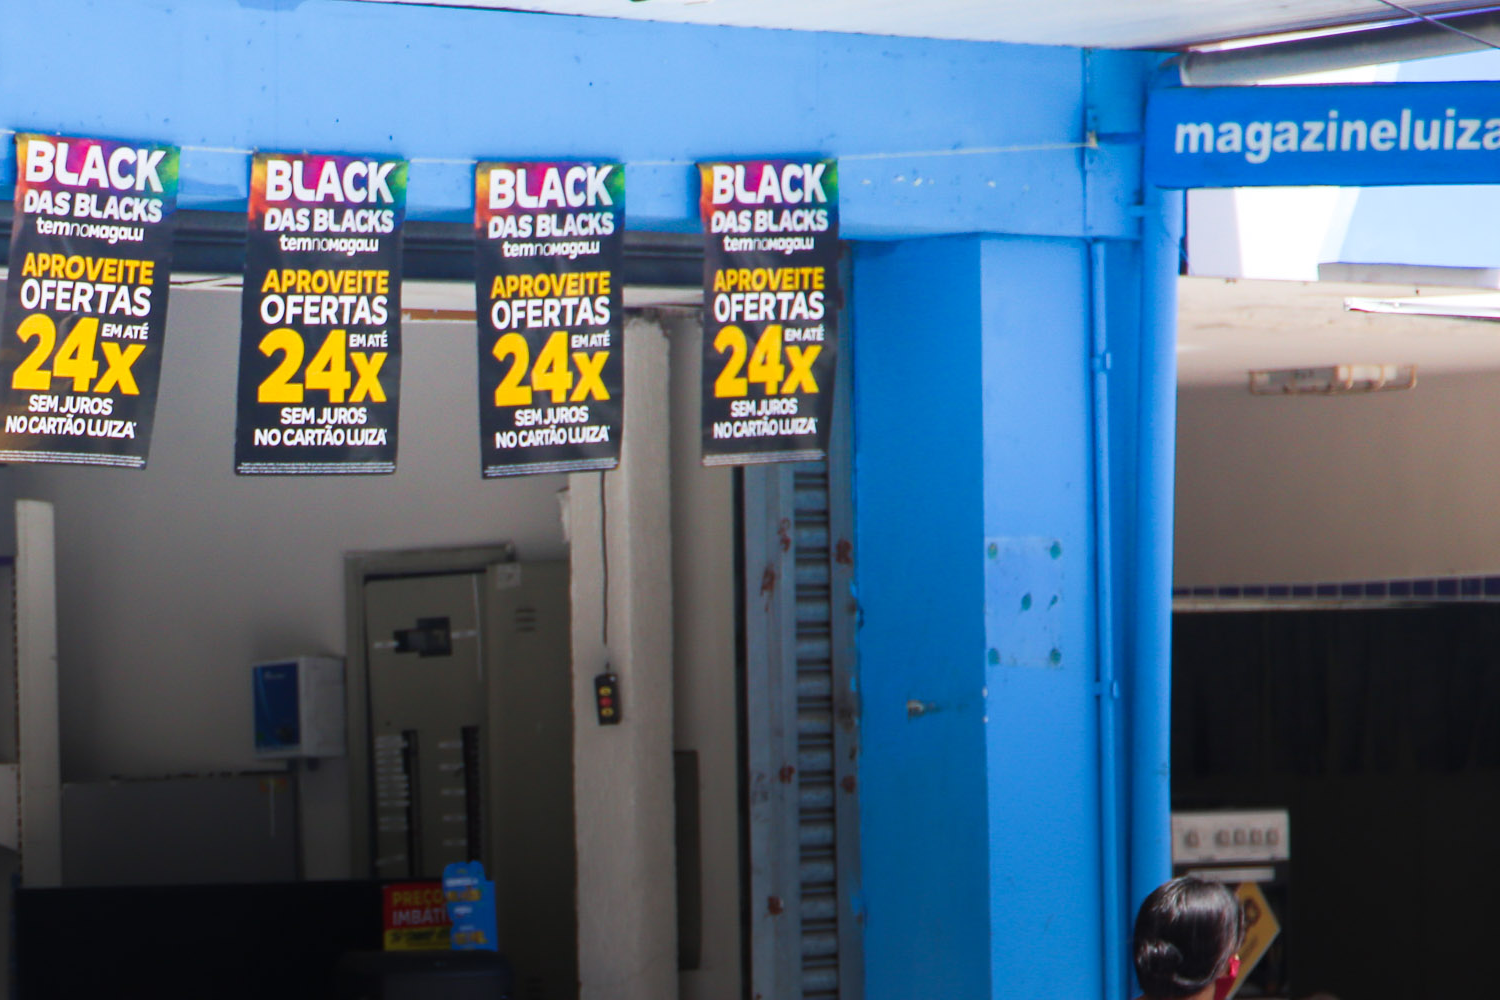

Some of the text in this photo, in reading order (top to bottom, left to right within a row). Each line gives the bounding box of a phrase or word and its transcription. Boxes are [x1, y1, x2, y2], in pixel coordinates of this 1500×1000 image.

[1175, 108, 1500, 164] magazineluiza
[265, 159, 396, 203] BLACK
[263, 207, 394, 233] DAS BLACKS
[261, 268, 390, 294] APROVEITE
[261, 294, 388, 325] OFERTAS
[349, 330, 388, 348] EM ATÉ
[280, 406, 367, 427] SEM JUROS
[254, 429, 285, 446] NO
[283, 423, 346, 446] CARTÃO
